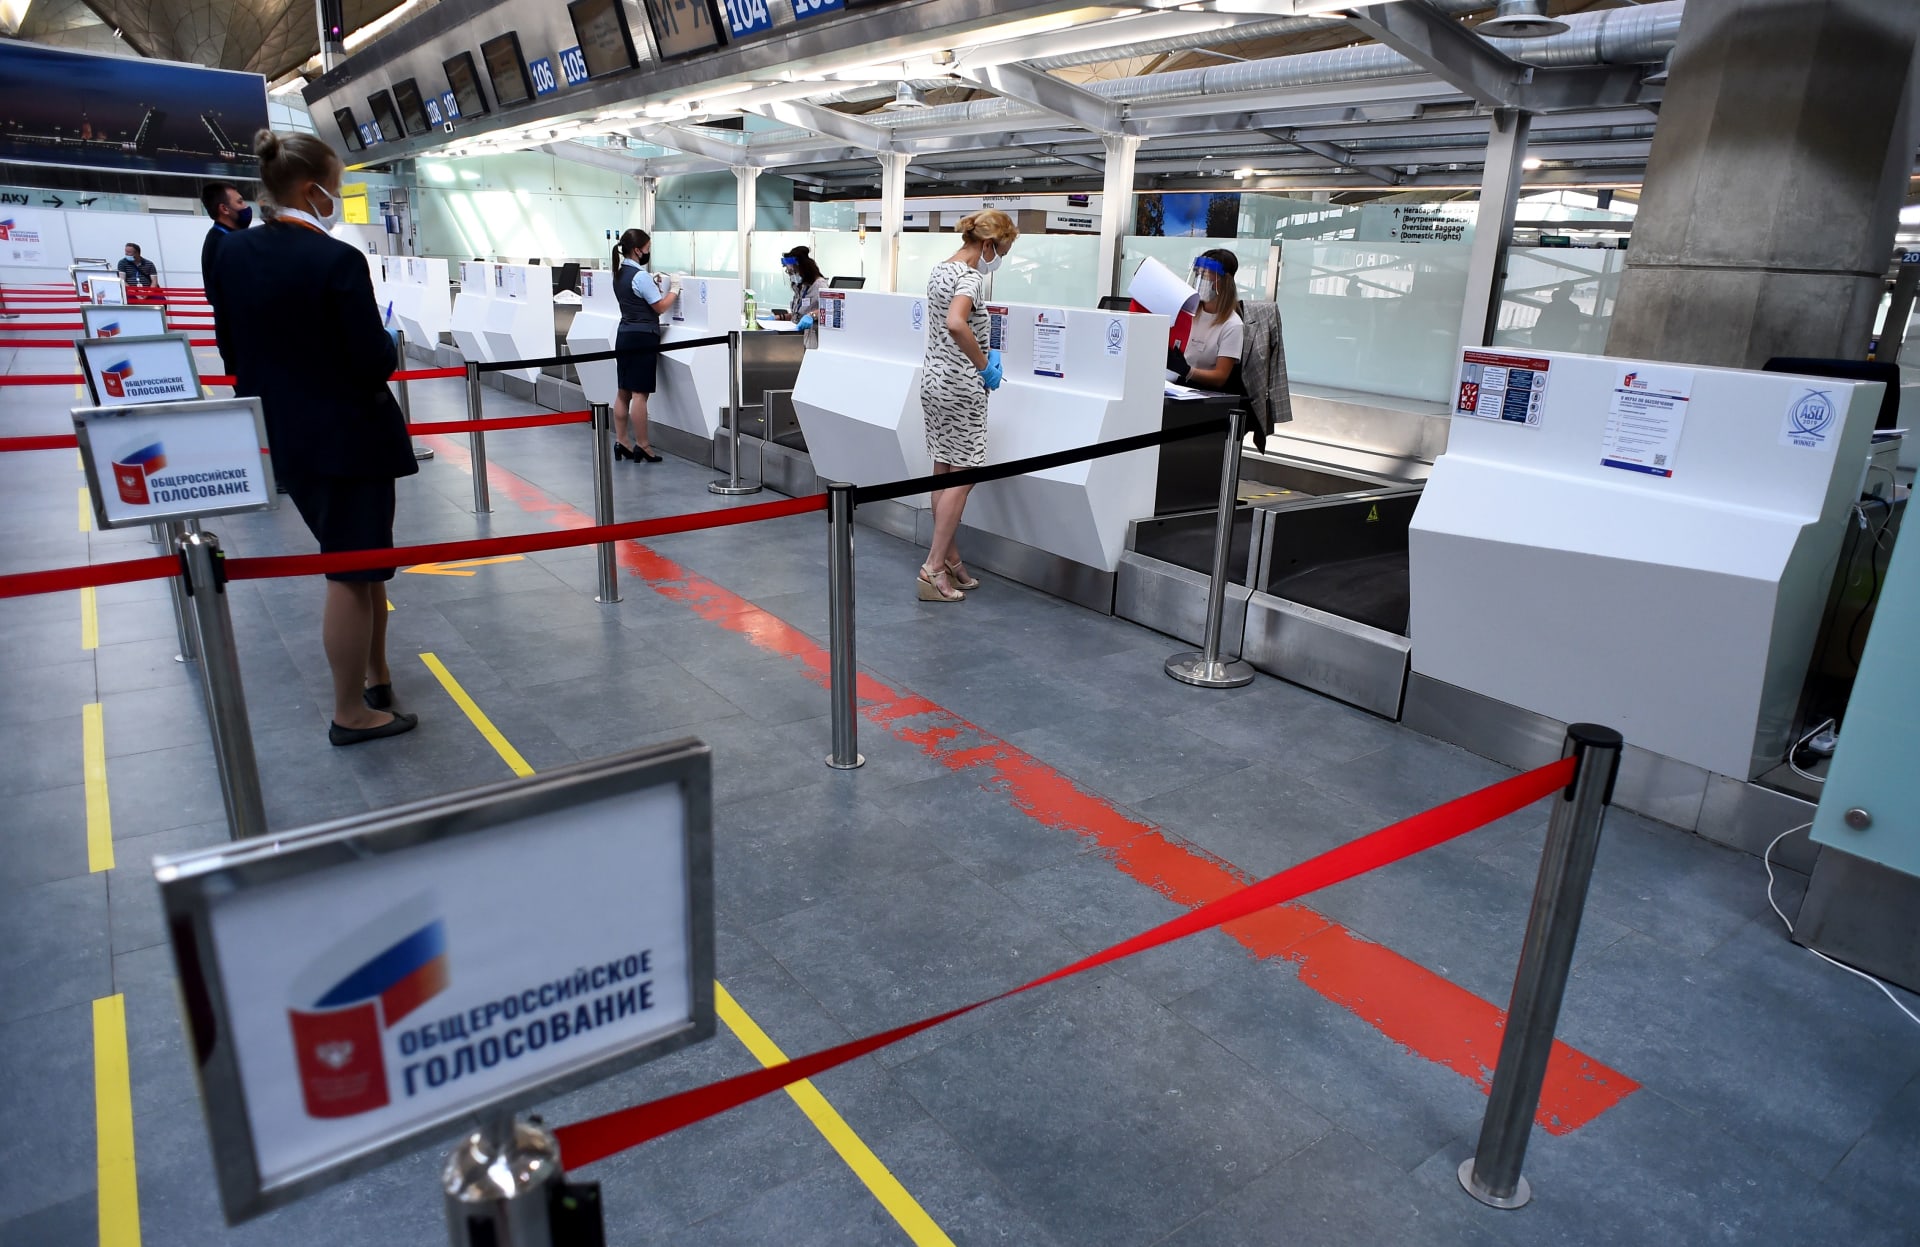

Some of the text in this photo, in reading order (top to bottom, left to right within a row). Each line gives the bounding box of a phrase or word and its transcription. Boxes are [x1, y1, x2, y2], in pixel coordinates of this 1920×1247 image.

[727, 0, 766, 32] 104
[533, 61, 555, 92] 106
[563, 50, 588, 82] 105
[443, 93, 459, 116] 107
[1400, 231, 1462, 242] (Domestic Flights)
[1402, 223, 1465, 233] Oversized Baggage
[125, 376, 183, 388] ОБЩЕРОССИЙСКОЕ
[127, 384, 186, 397] ГОЛОСОВАНИЕ
[1800, 404, 1825, 421] ASQ
[1793, 439, 1816, 447] WINNER
[151, 469, 248, 488] ОБЩЕРОССИЙСКОЕ
[153, 480, 251, 503] ГОЛОСОВАНИЕ
[400, 950, 653, 1056] ОБЩЕРОССИЙСКОЕ
[403, 980, 656, 1097] ГОЛОСОВАНИЕ
